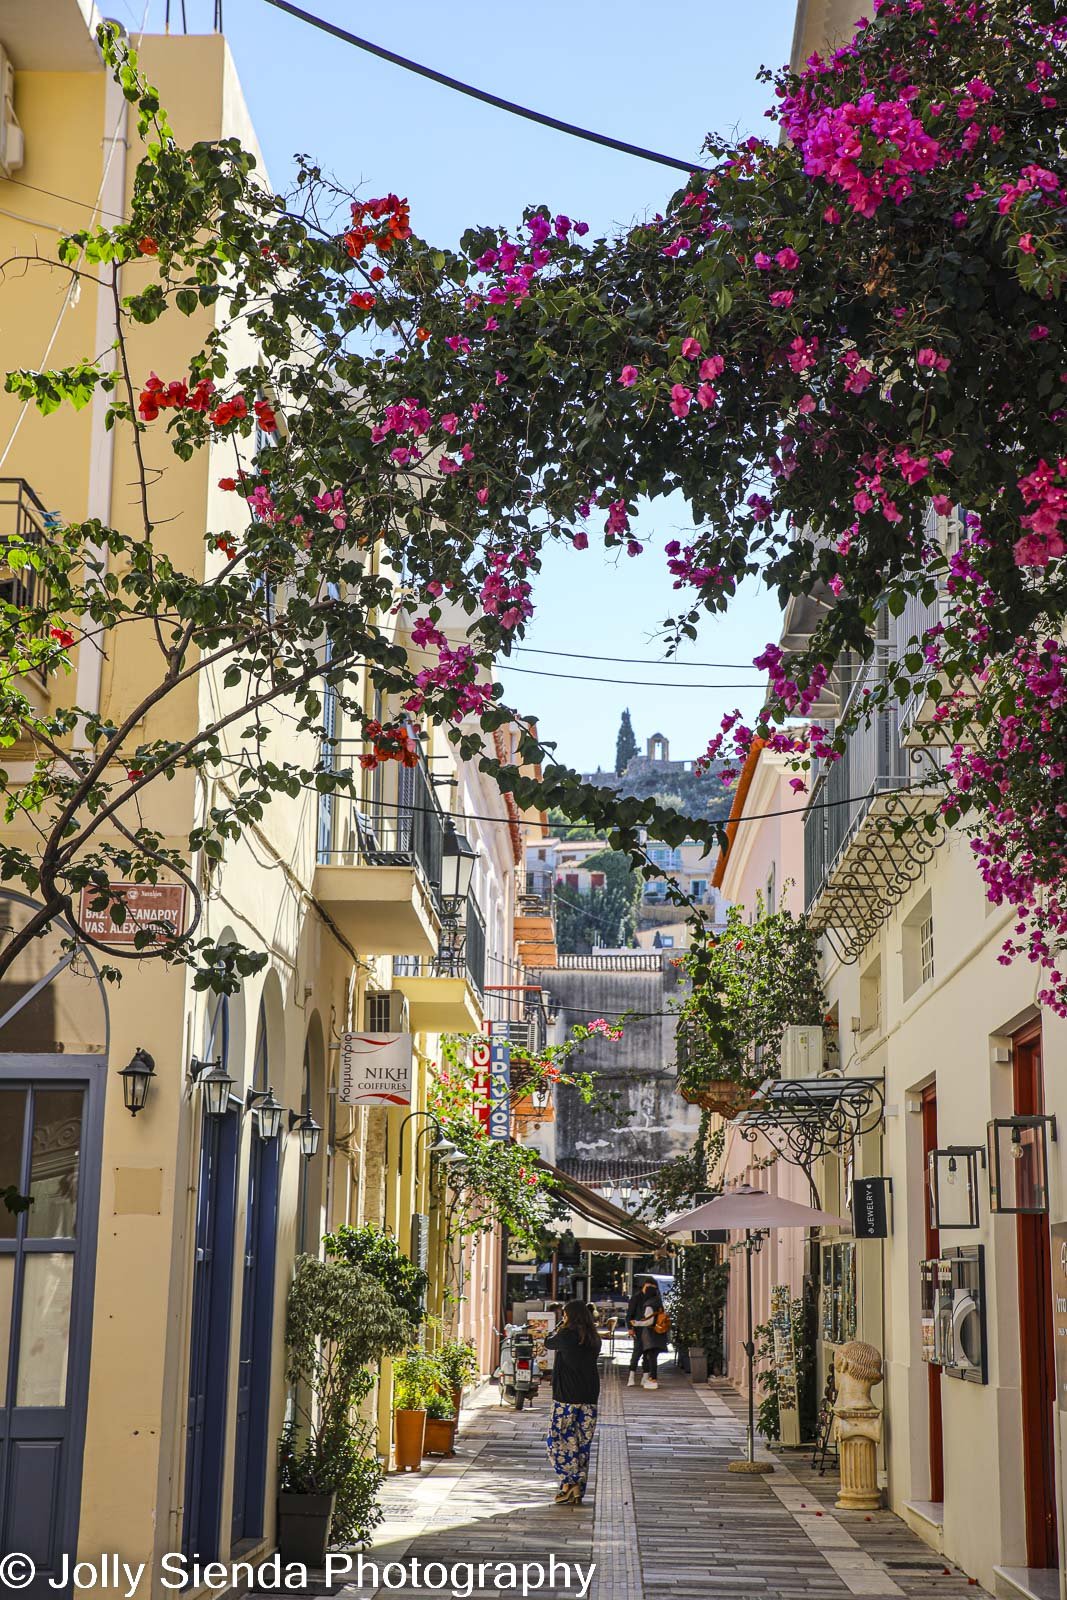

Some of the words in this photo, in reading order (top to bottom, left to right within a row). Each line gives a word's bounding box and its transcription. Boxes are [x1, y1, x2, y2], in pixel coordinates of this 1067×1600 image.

[110, 908, 178, 921] ΕΞΑΝΔΡΟΥ
[84, 921, 107, 934] VAS.
[358, 1082, 407, 1090] COIFFURES
[866, 1190, 875, 1227] JEWELRY
